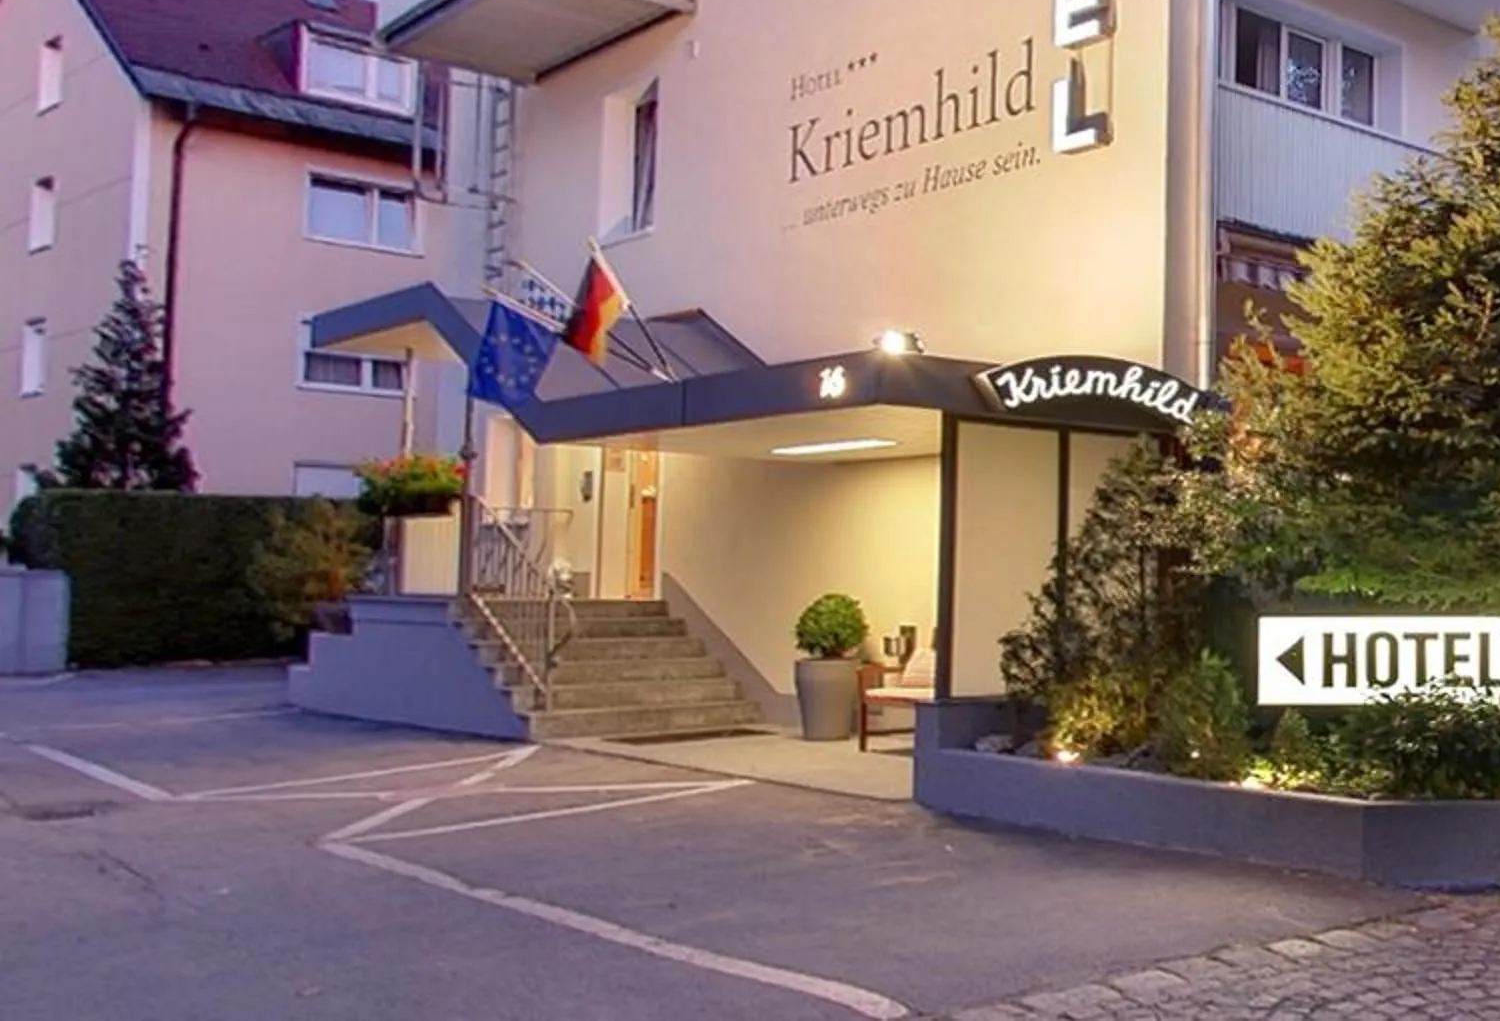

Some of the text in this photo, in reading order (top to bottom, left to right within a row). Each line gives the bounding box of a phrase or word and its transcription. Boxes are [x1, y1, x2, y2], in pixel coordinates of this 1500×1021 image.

[788, 36, 1035, 183] Kriemhild
[893, 179, 917, 202] zu
[921, 162, 988, 195] Hause
[991, 141, 1042, 177] sein.
[996, 365, 1198, 425] Kriemhild
